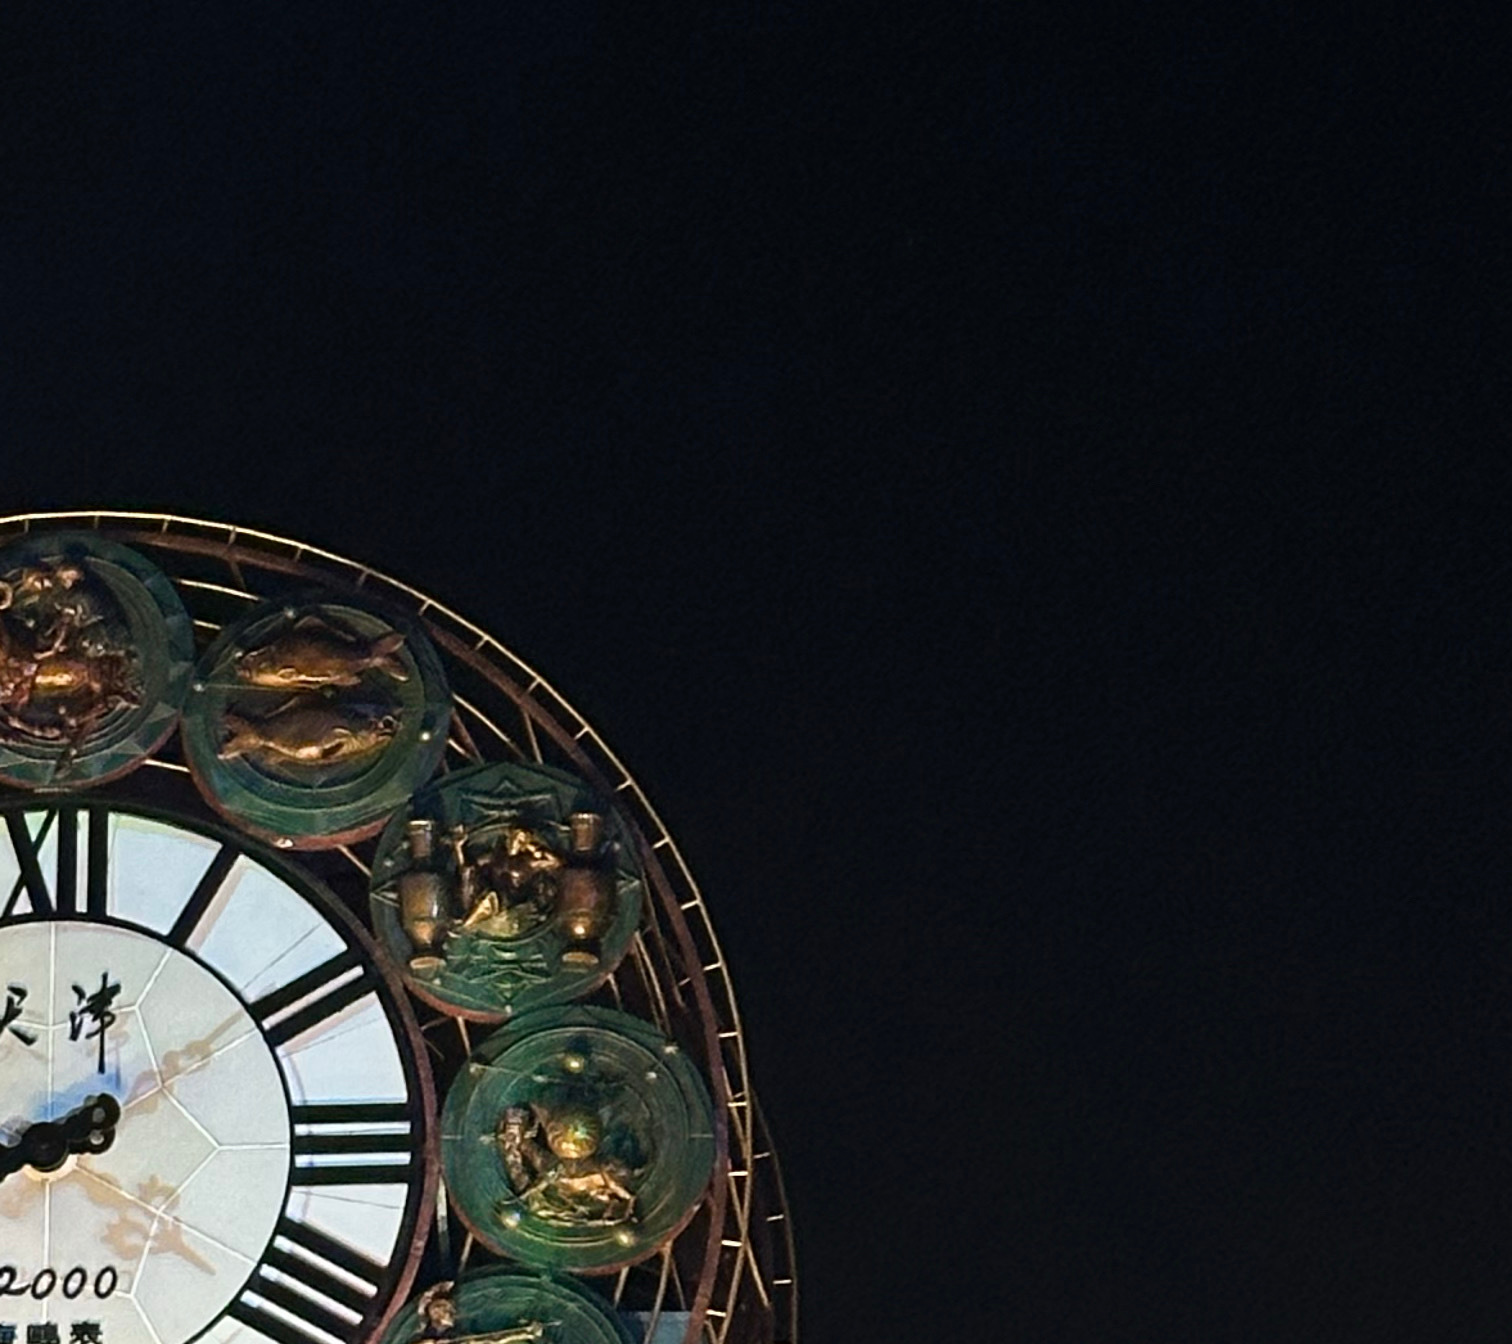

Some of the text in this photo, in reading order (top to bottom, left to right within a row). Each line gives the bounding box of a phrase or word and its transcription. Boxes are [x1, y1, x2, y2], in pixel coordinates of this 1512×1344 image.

[5, 810, 108, 914] XII
[168, 844, 240, 946] I
[250, 947, 377, 1048] II
[291, 1104, 410, 1185] III
